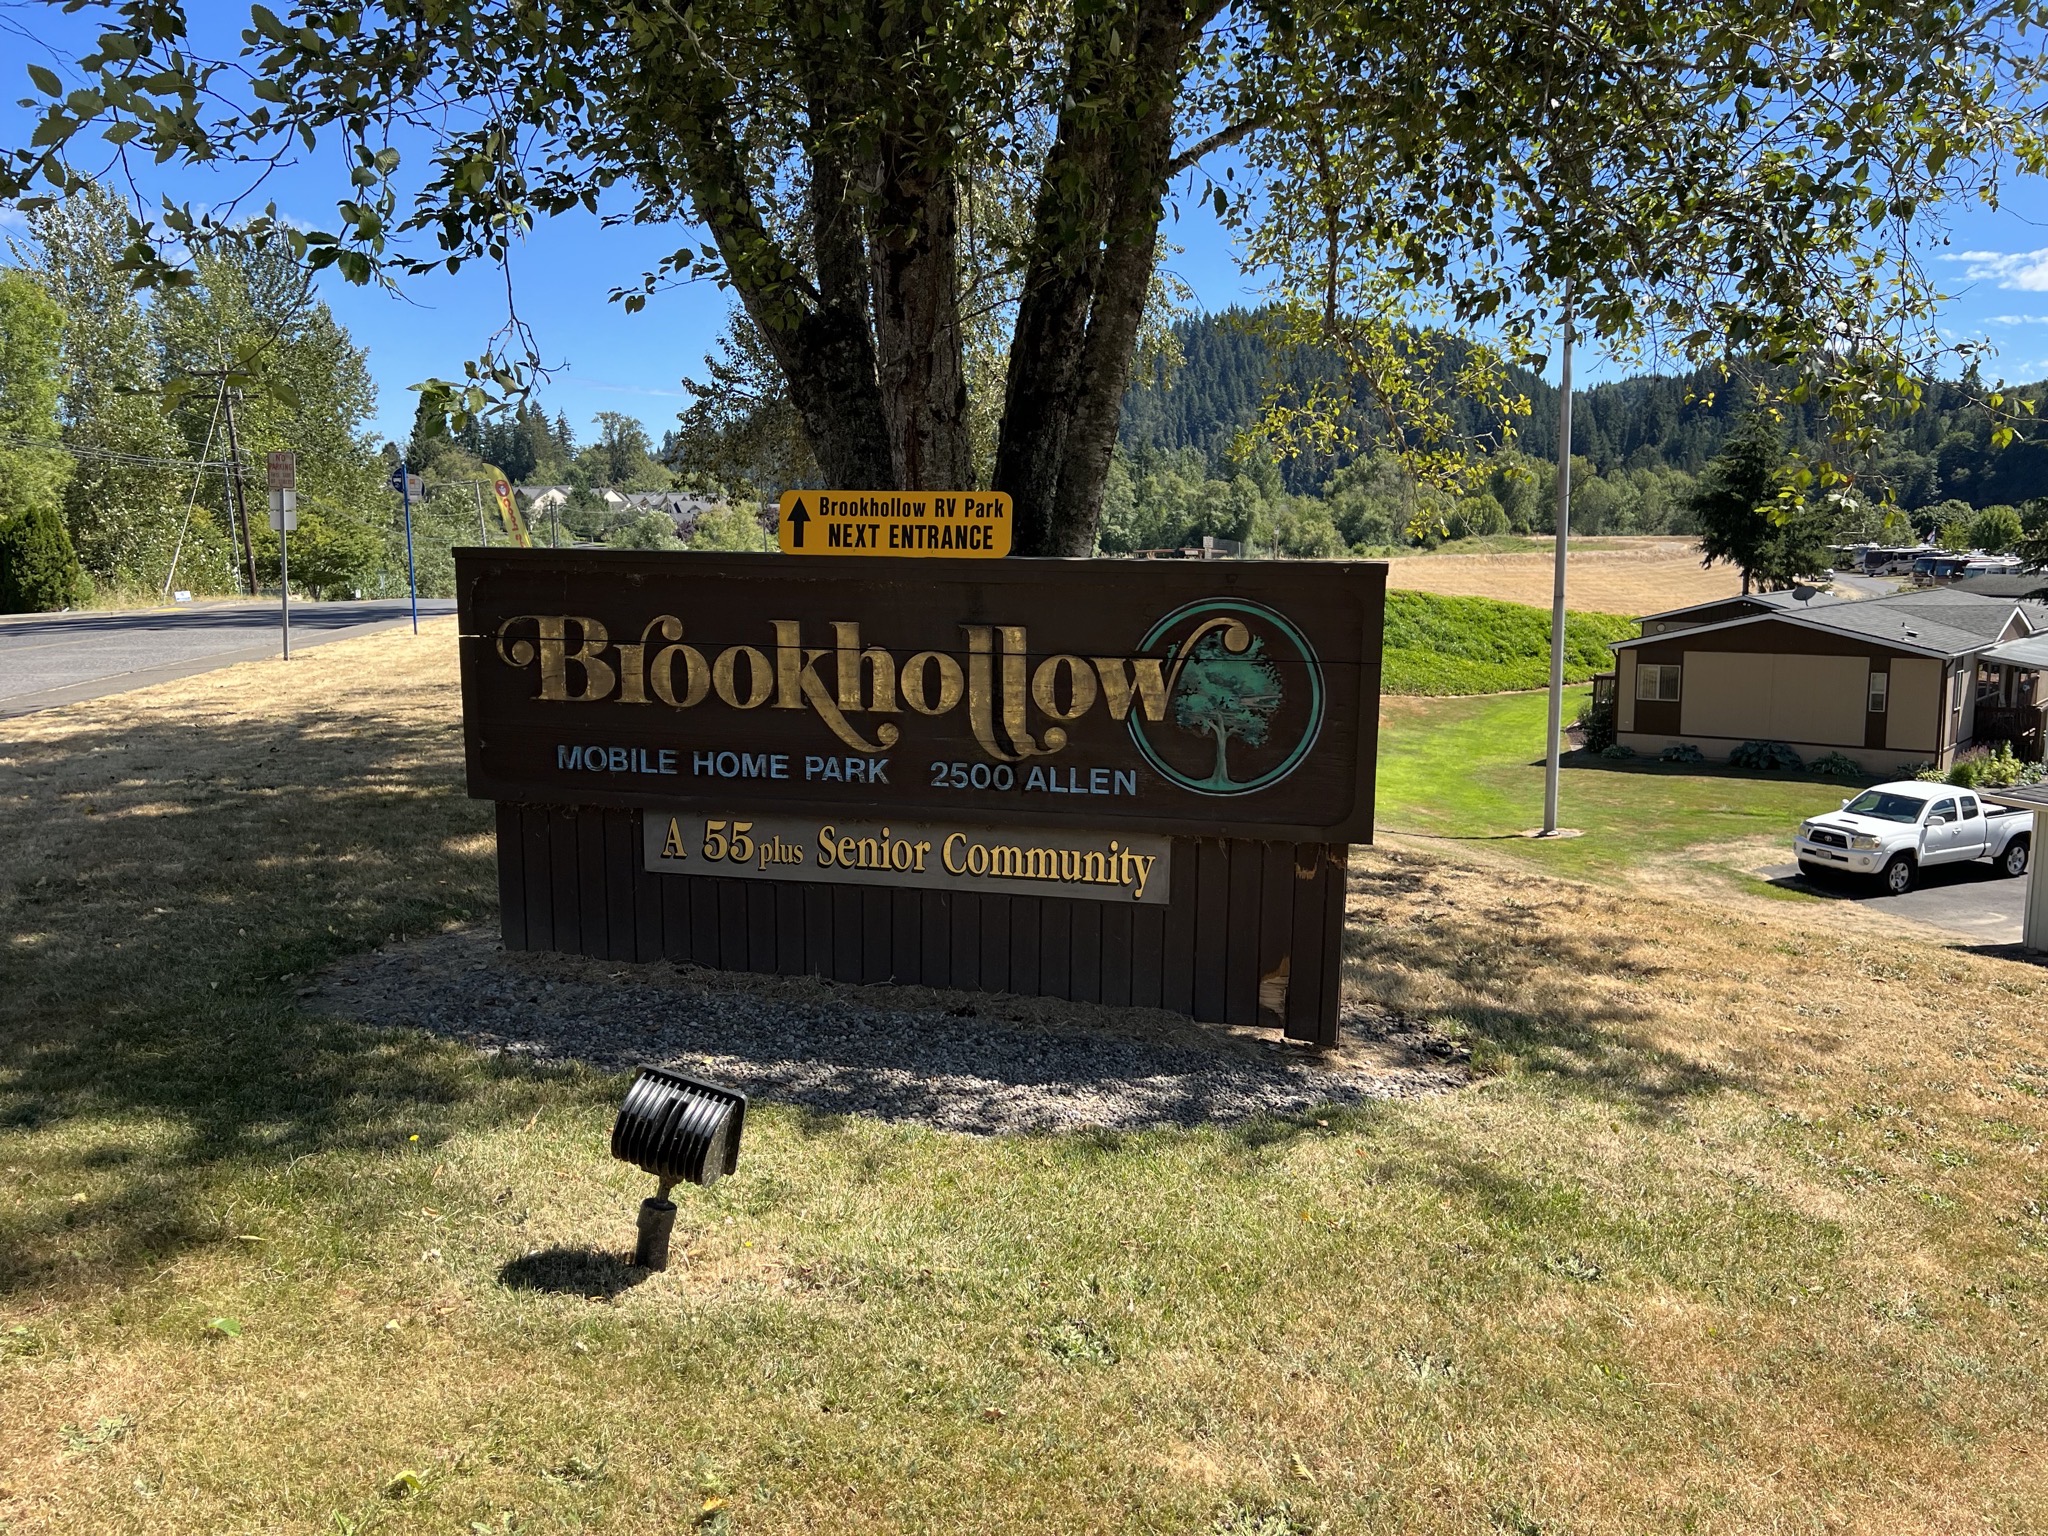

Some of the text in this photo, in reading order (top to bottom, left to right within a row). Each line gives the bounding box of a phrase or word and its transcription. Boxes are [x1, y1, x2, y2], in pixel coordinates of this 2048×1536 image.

[269, 463, 293, 471] PARKING
[275, 454, 286, 462] NO
[819, 497, 1004, 518] Brookhollow RV Park
[828, 523, 993, 550] NEXT ENTRANCE
[496, 613, 1250, 762] Brookhollow
[557, 744, 1136, 796] MOBILE HOME PARK 2500 ALLEN
[661, 817, 1157, 900] A 55 plus Senior Community
